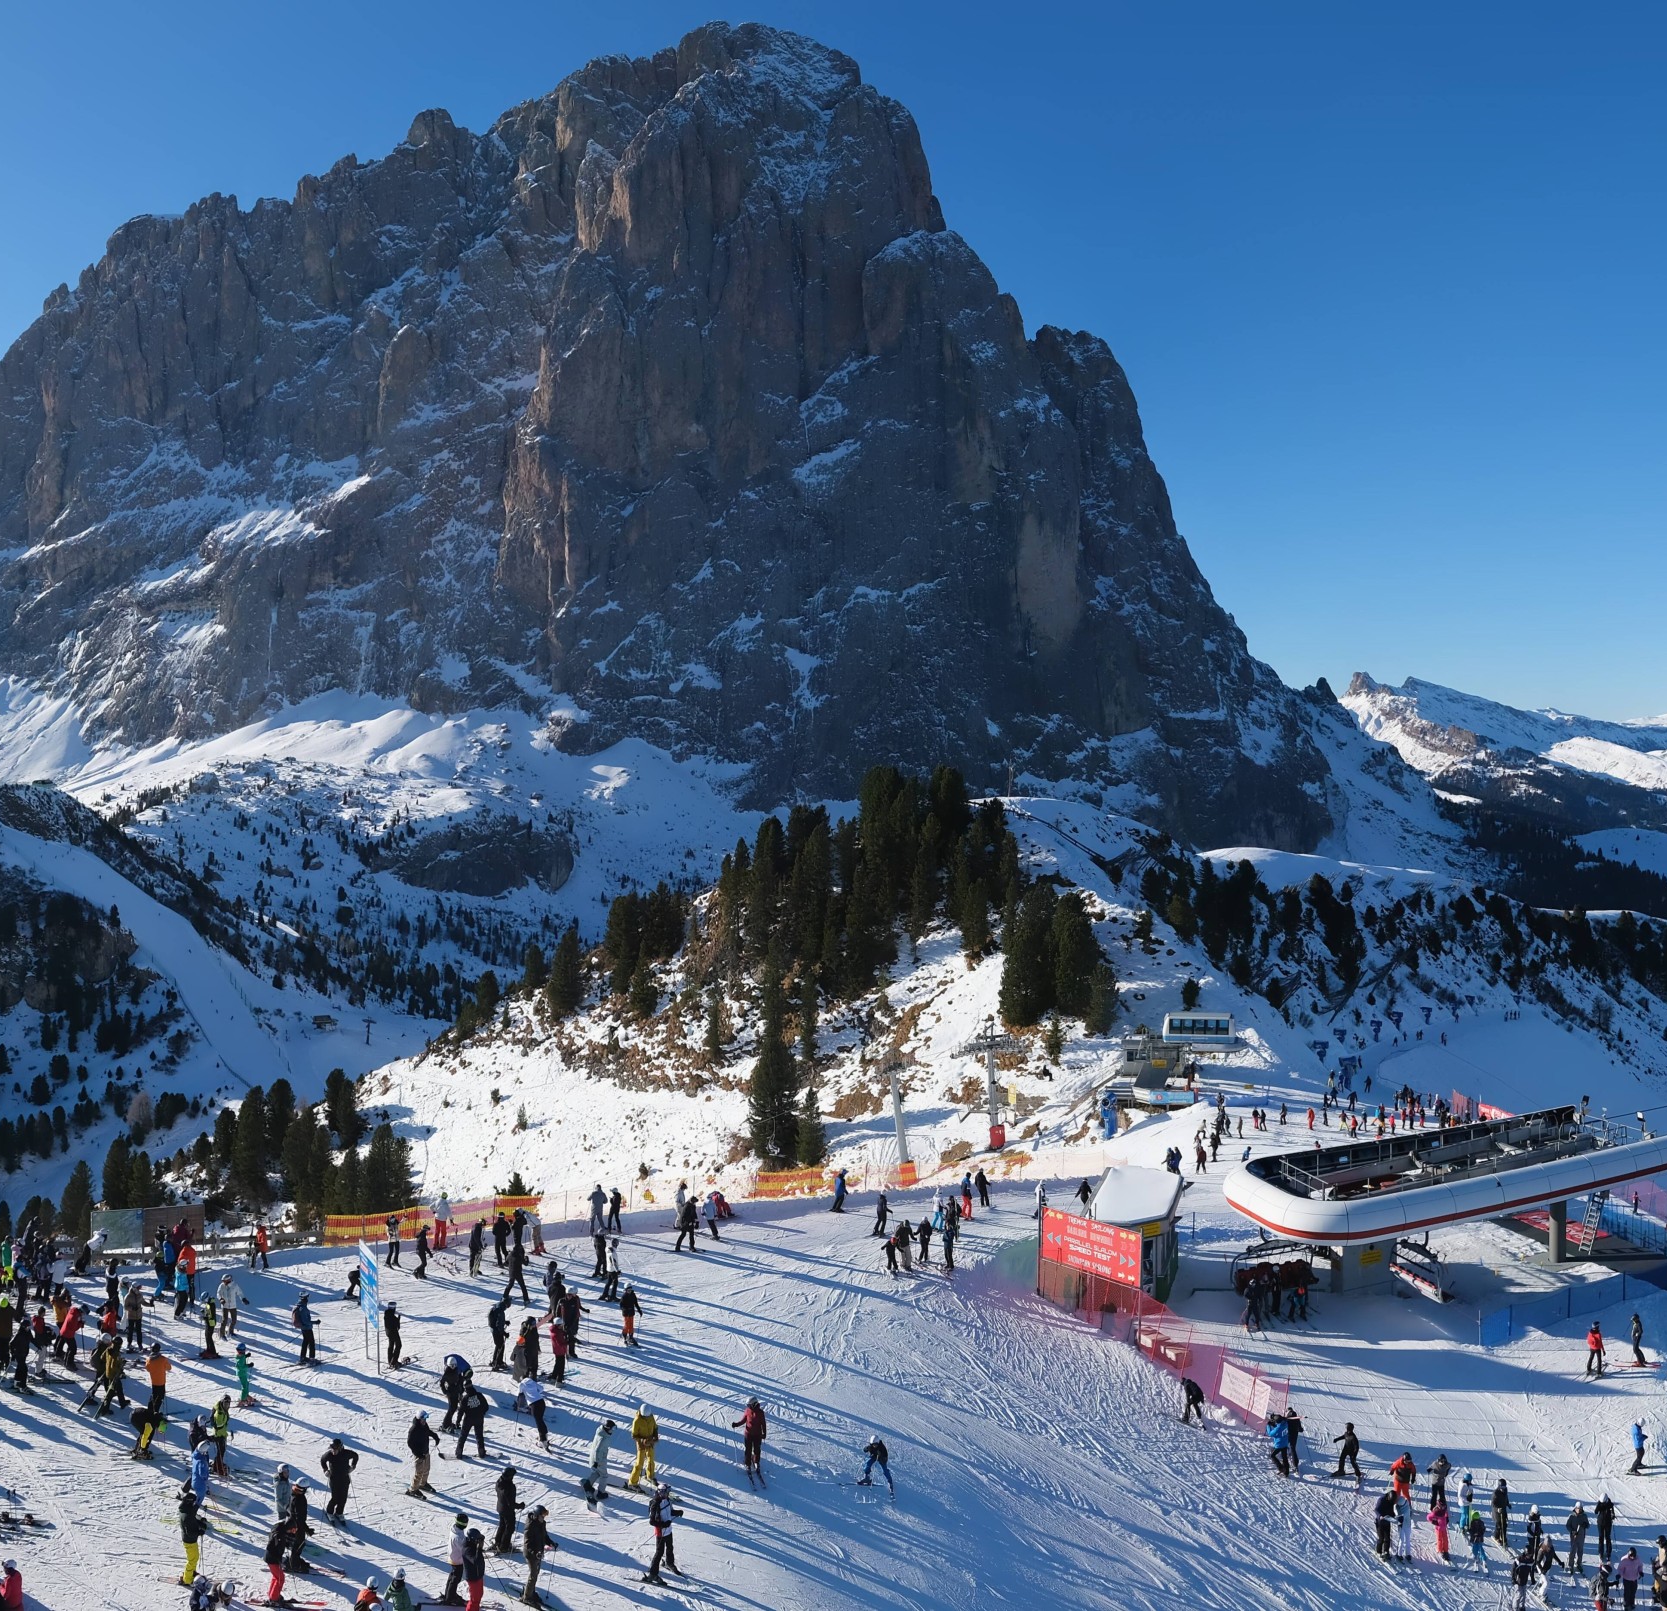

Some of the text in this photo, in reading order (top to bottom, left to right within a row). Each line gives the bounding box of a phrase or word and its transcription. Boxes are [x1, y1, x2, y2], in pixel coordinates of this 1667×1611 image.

[1063, 1235, 1117, 1257] PARALLEL SLALOM
[1068, 1243, 1111, 1261] SPEED TEST
